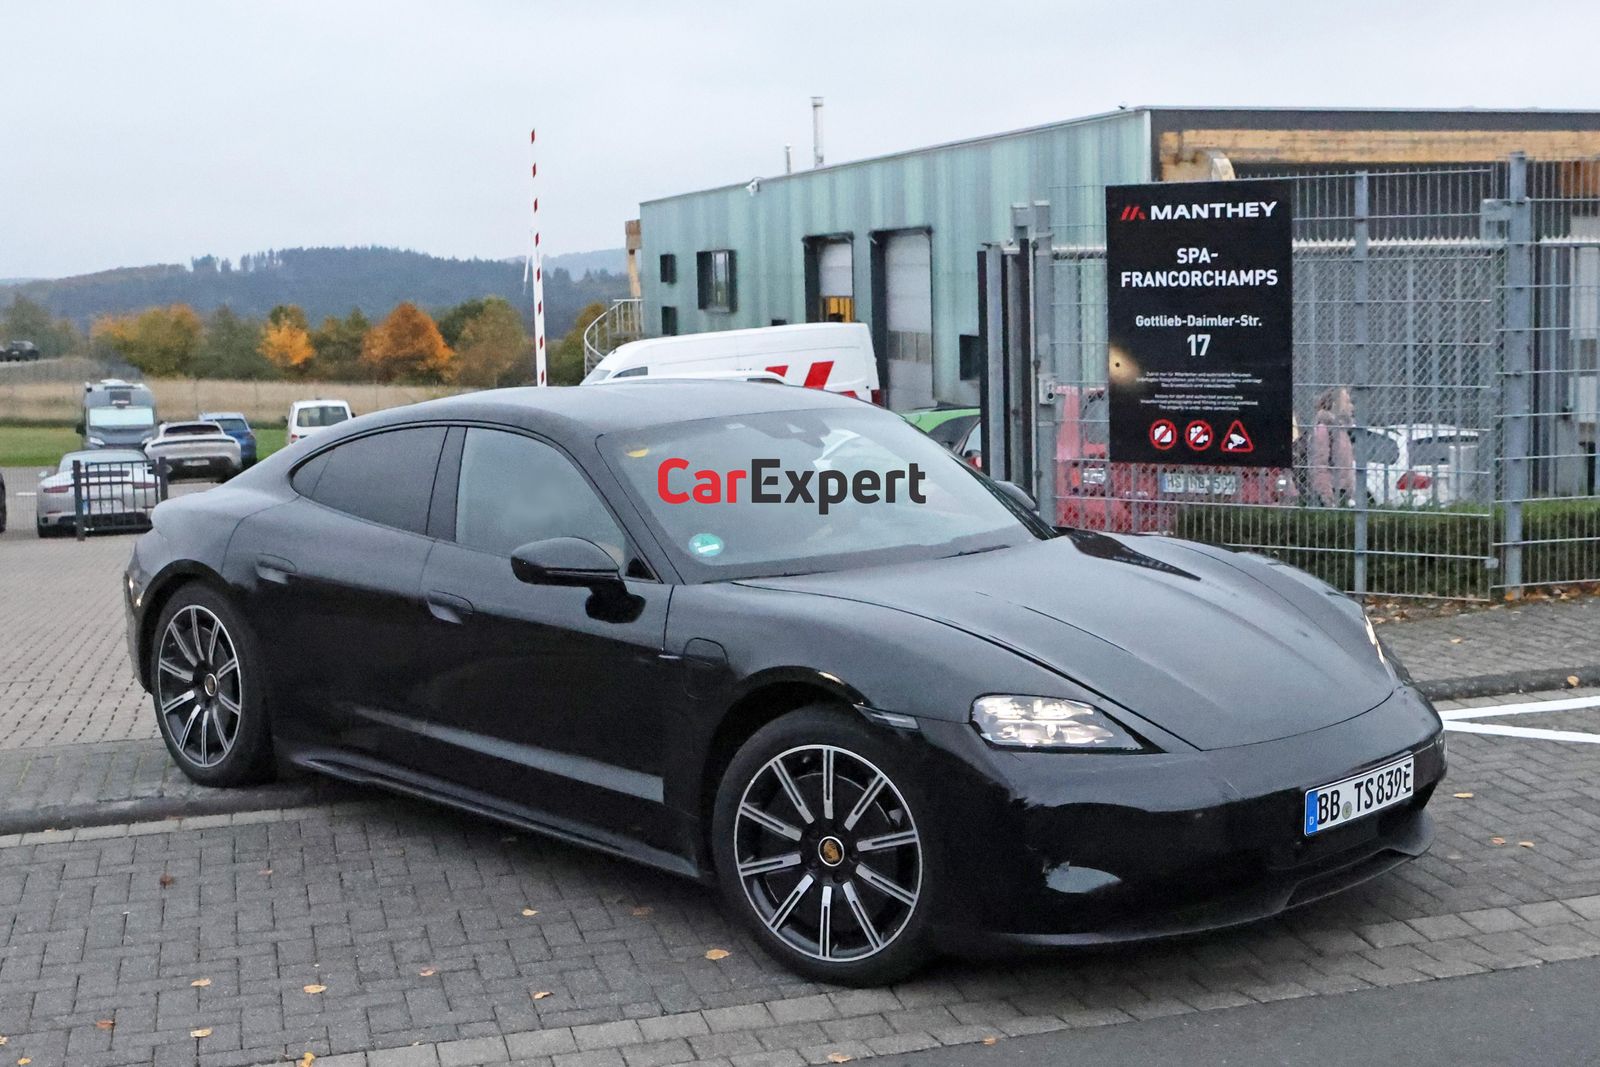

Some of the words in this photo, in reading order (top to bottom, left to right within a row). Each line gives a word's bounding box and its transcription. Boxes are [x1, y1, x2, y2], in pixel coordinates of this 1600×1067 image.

[1150, 201, 1278, 221] MANTHEY
[1176, 247, 1219, 264] SPA-
[1120, 269, 1279, 288] FRANCORCHAMPS
[1135, 314, 1263, 327] Gottlieb-Daimler-Str.
[1186, 333, 1212, 357] 17
[1317, 789, 1341, 825] BB
